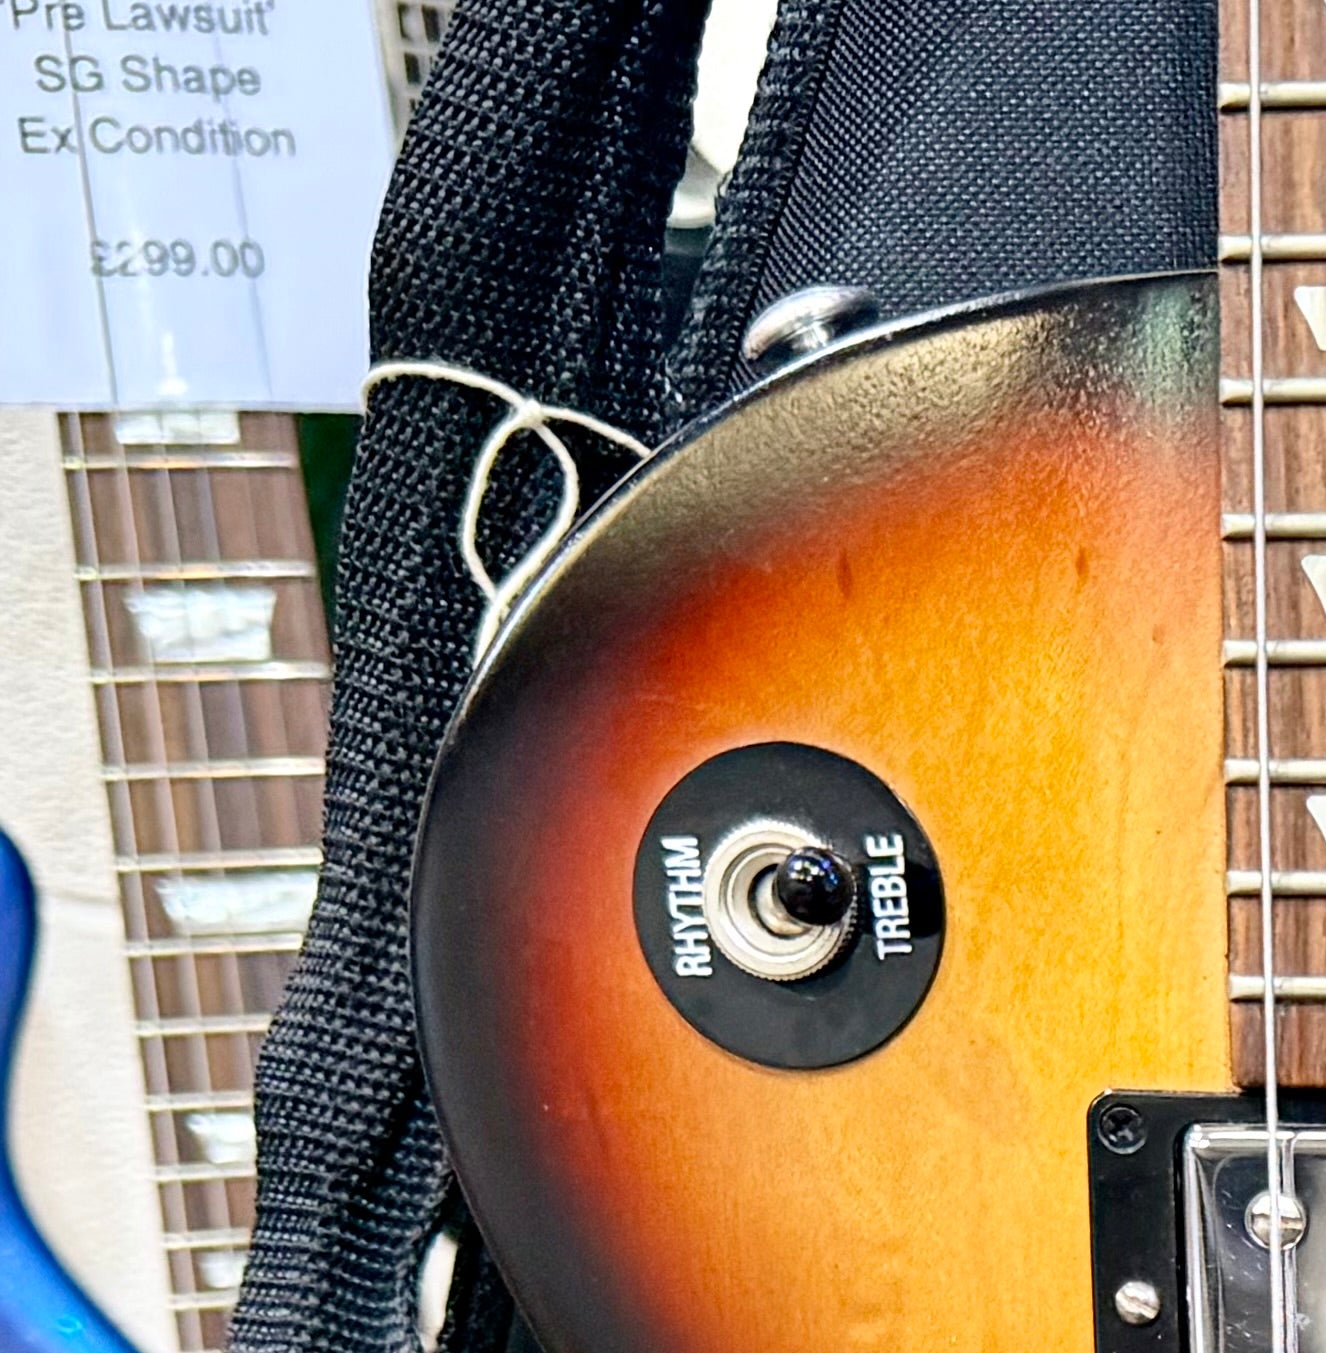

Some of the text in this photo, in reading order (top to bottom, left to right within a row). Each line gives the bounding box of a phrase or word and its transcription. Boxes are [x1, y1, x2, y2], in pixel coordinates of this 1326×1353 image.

[33, 53, 262, 102] SG Shape
[17, 115, 297, 157] Ex Condition
[90, 238, 265, 279] £299.00
[660, 835, 713, 977] RHYTHM
[865, 833, 913, 960] TREBLE
